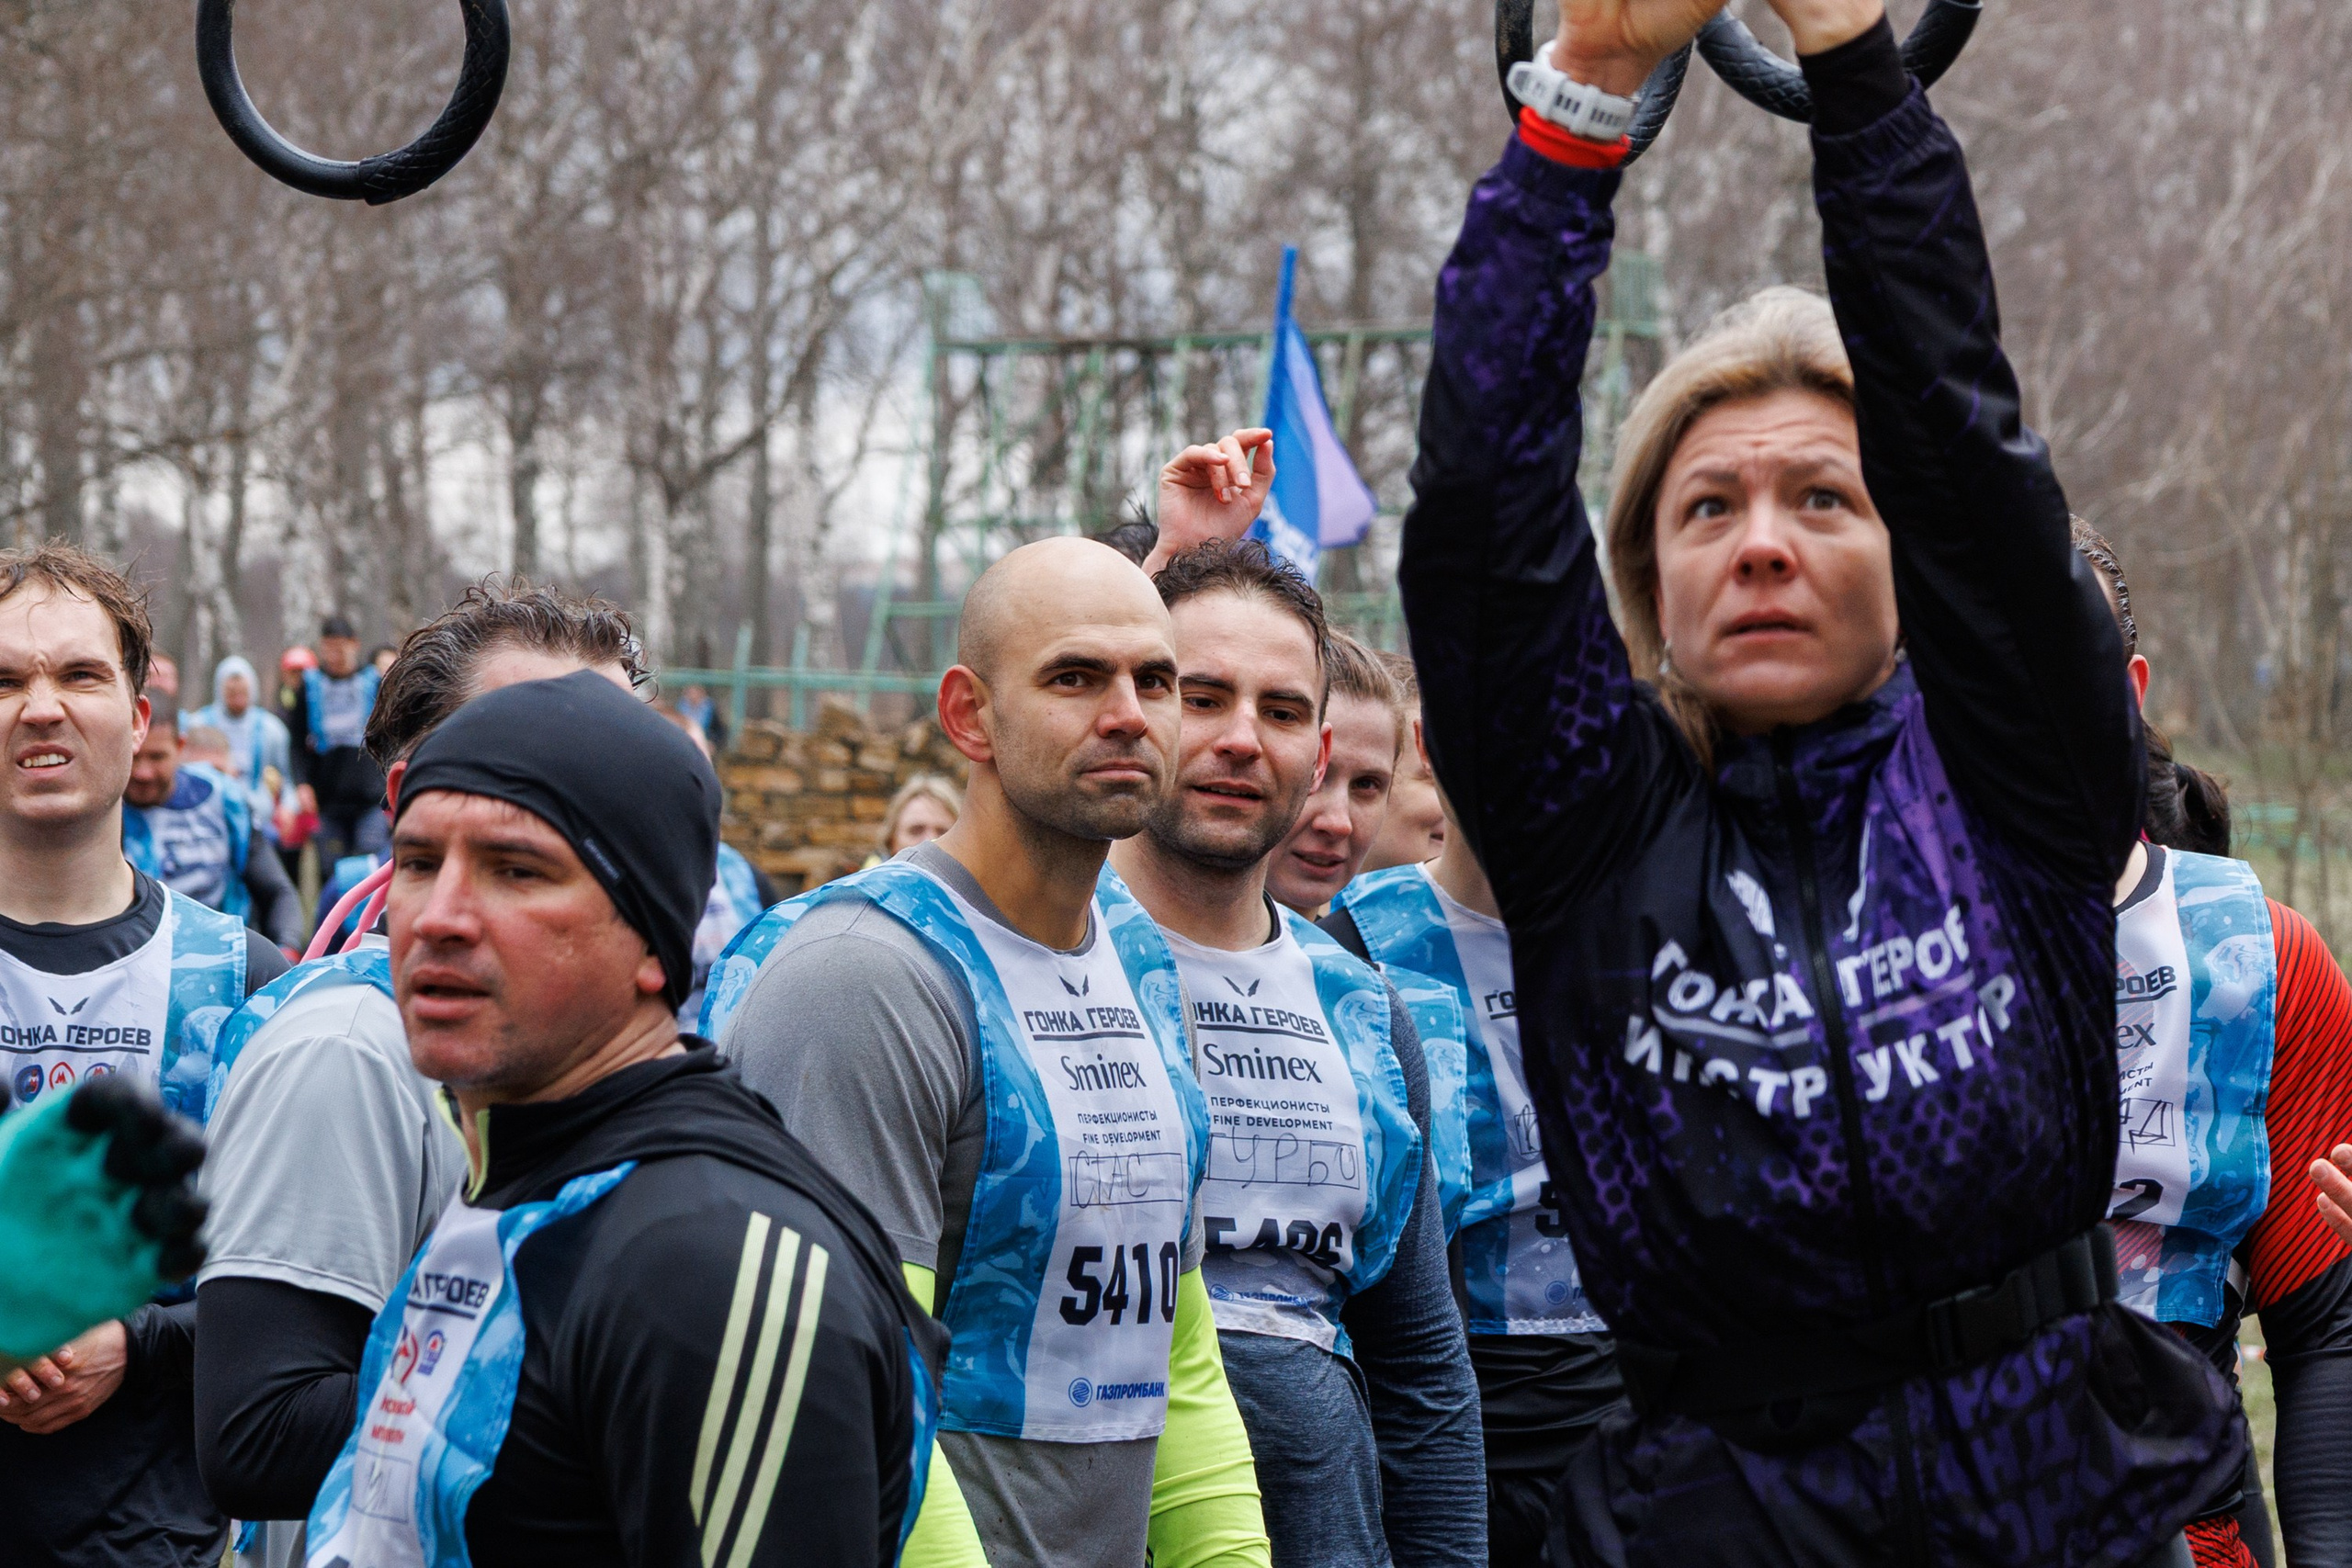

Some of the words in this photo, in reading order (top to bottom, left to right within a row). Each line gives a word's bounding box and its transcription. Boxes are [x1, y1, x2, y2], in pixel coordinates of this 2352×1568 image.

[1836, 905, 1970, 1008] ГЕРОЕ
[2116, 965, 2177, 995] РОЕВ
[1023, 1010, 1085, 1032] ГОНКА
[1086, 1007, 1141, 1030] ГЕРОЕВ
[1250, 1007, 1325, 1037] ГЕРОЕВ
[0, 1024, 58, 1046] ОНКА
[66, 1024, 152, 1046] ГЕРОЕВ
[1060, 1053, 1147, 1091] Sminex
[1203, 1043, 1322, 1084] Sminex
[1078, 1110, 1158, 1125] ПЕРФЕКЦИОНИСТЫ
[1210, 1097, 1330, 1114] ПЕРФЕКЦИОНИСТЫ
[1213, 1115, 1240, 1126] FINE
[1247, 1116, 1333, 1131] DEVELOPMENT
[1083, 1133, 1100, 1145] FINE
[1102, 1130, 1161, 1145] DEVELOPMENT
[1059, 1241, 1180, 1326] 5410
[1096, 1381, 1165, 1401] ГАЗПРОМБАНК
